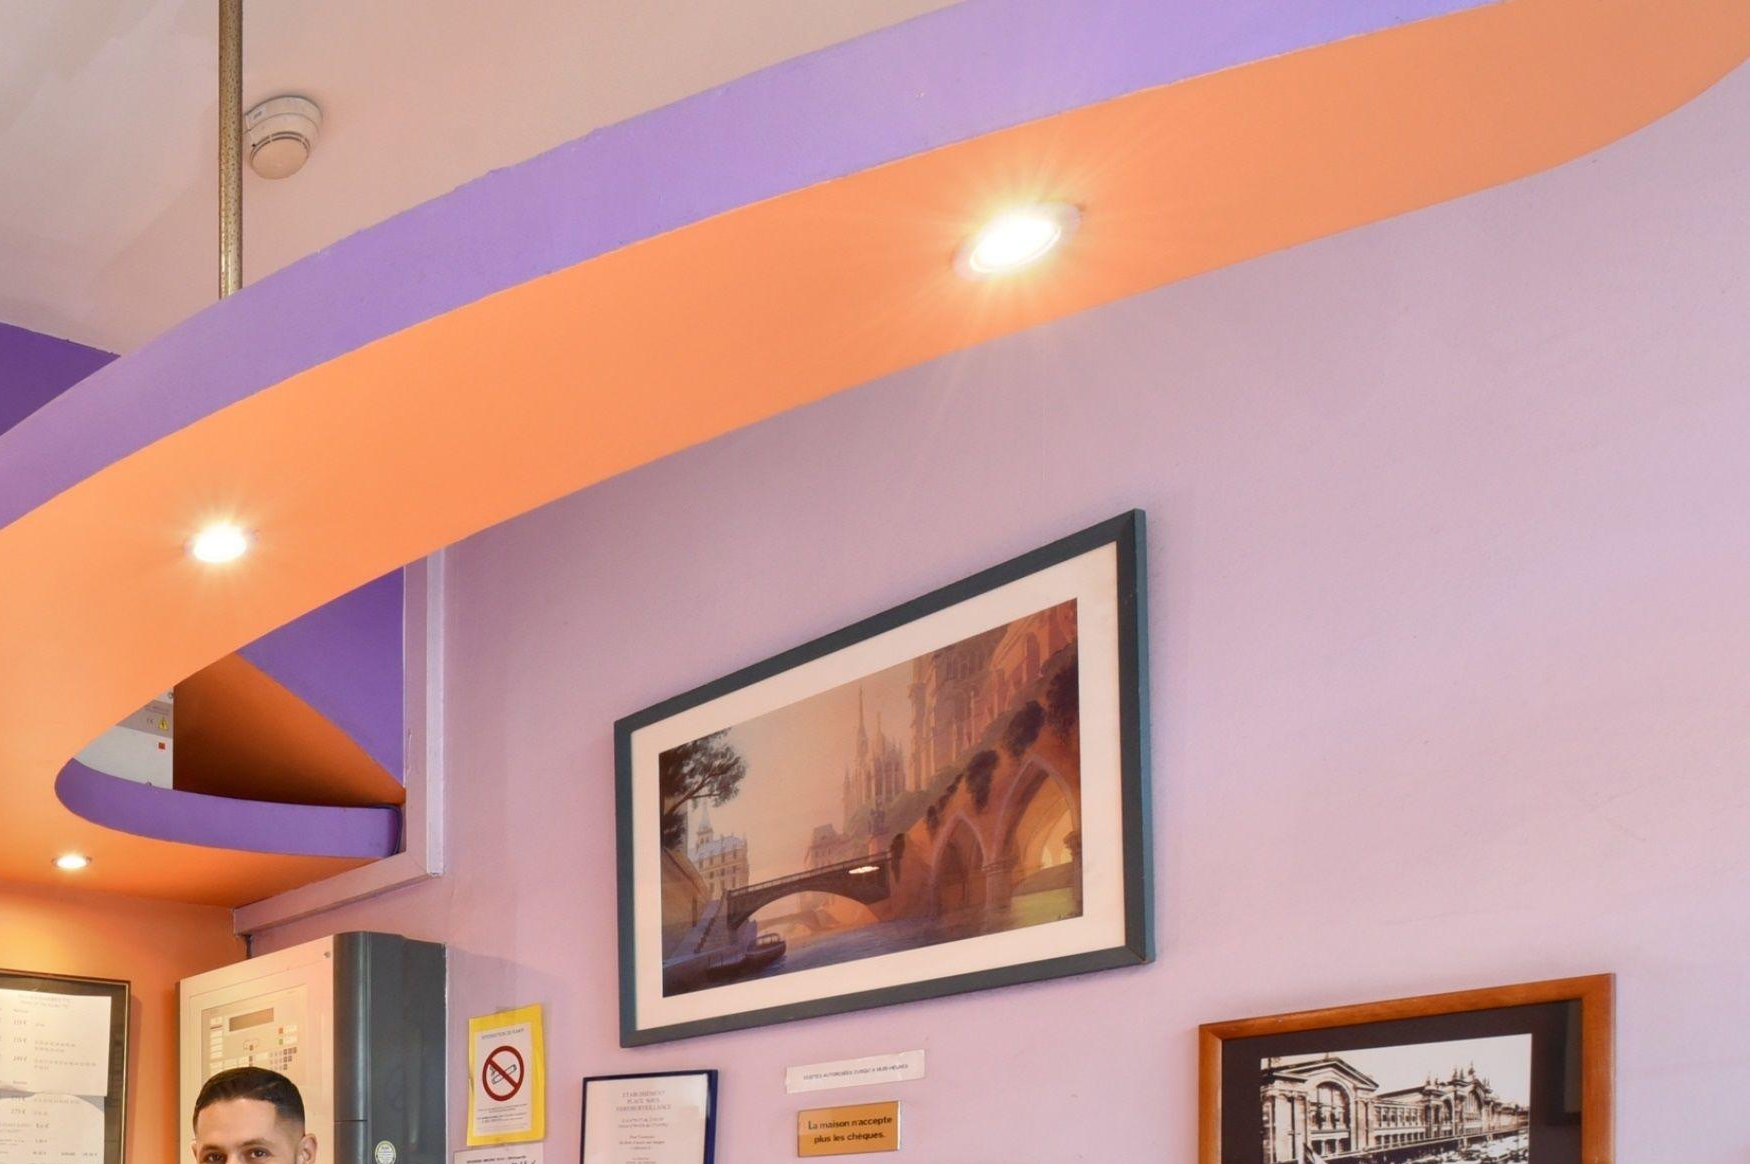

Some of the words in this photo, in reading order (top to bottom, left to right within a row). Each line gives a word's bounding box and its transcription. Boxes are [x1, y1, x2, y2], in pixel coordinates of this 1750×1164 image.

[808, 1120, 818, 1130] La
[820, 1120, 850, 1129] maison
[851, 1116, 893, 1127] n'accepte
[814, 1134, 831, 1144] plus
[833, 1133, 845, 1141] les
